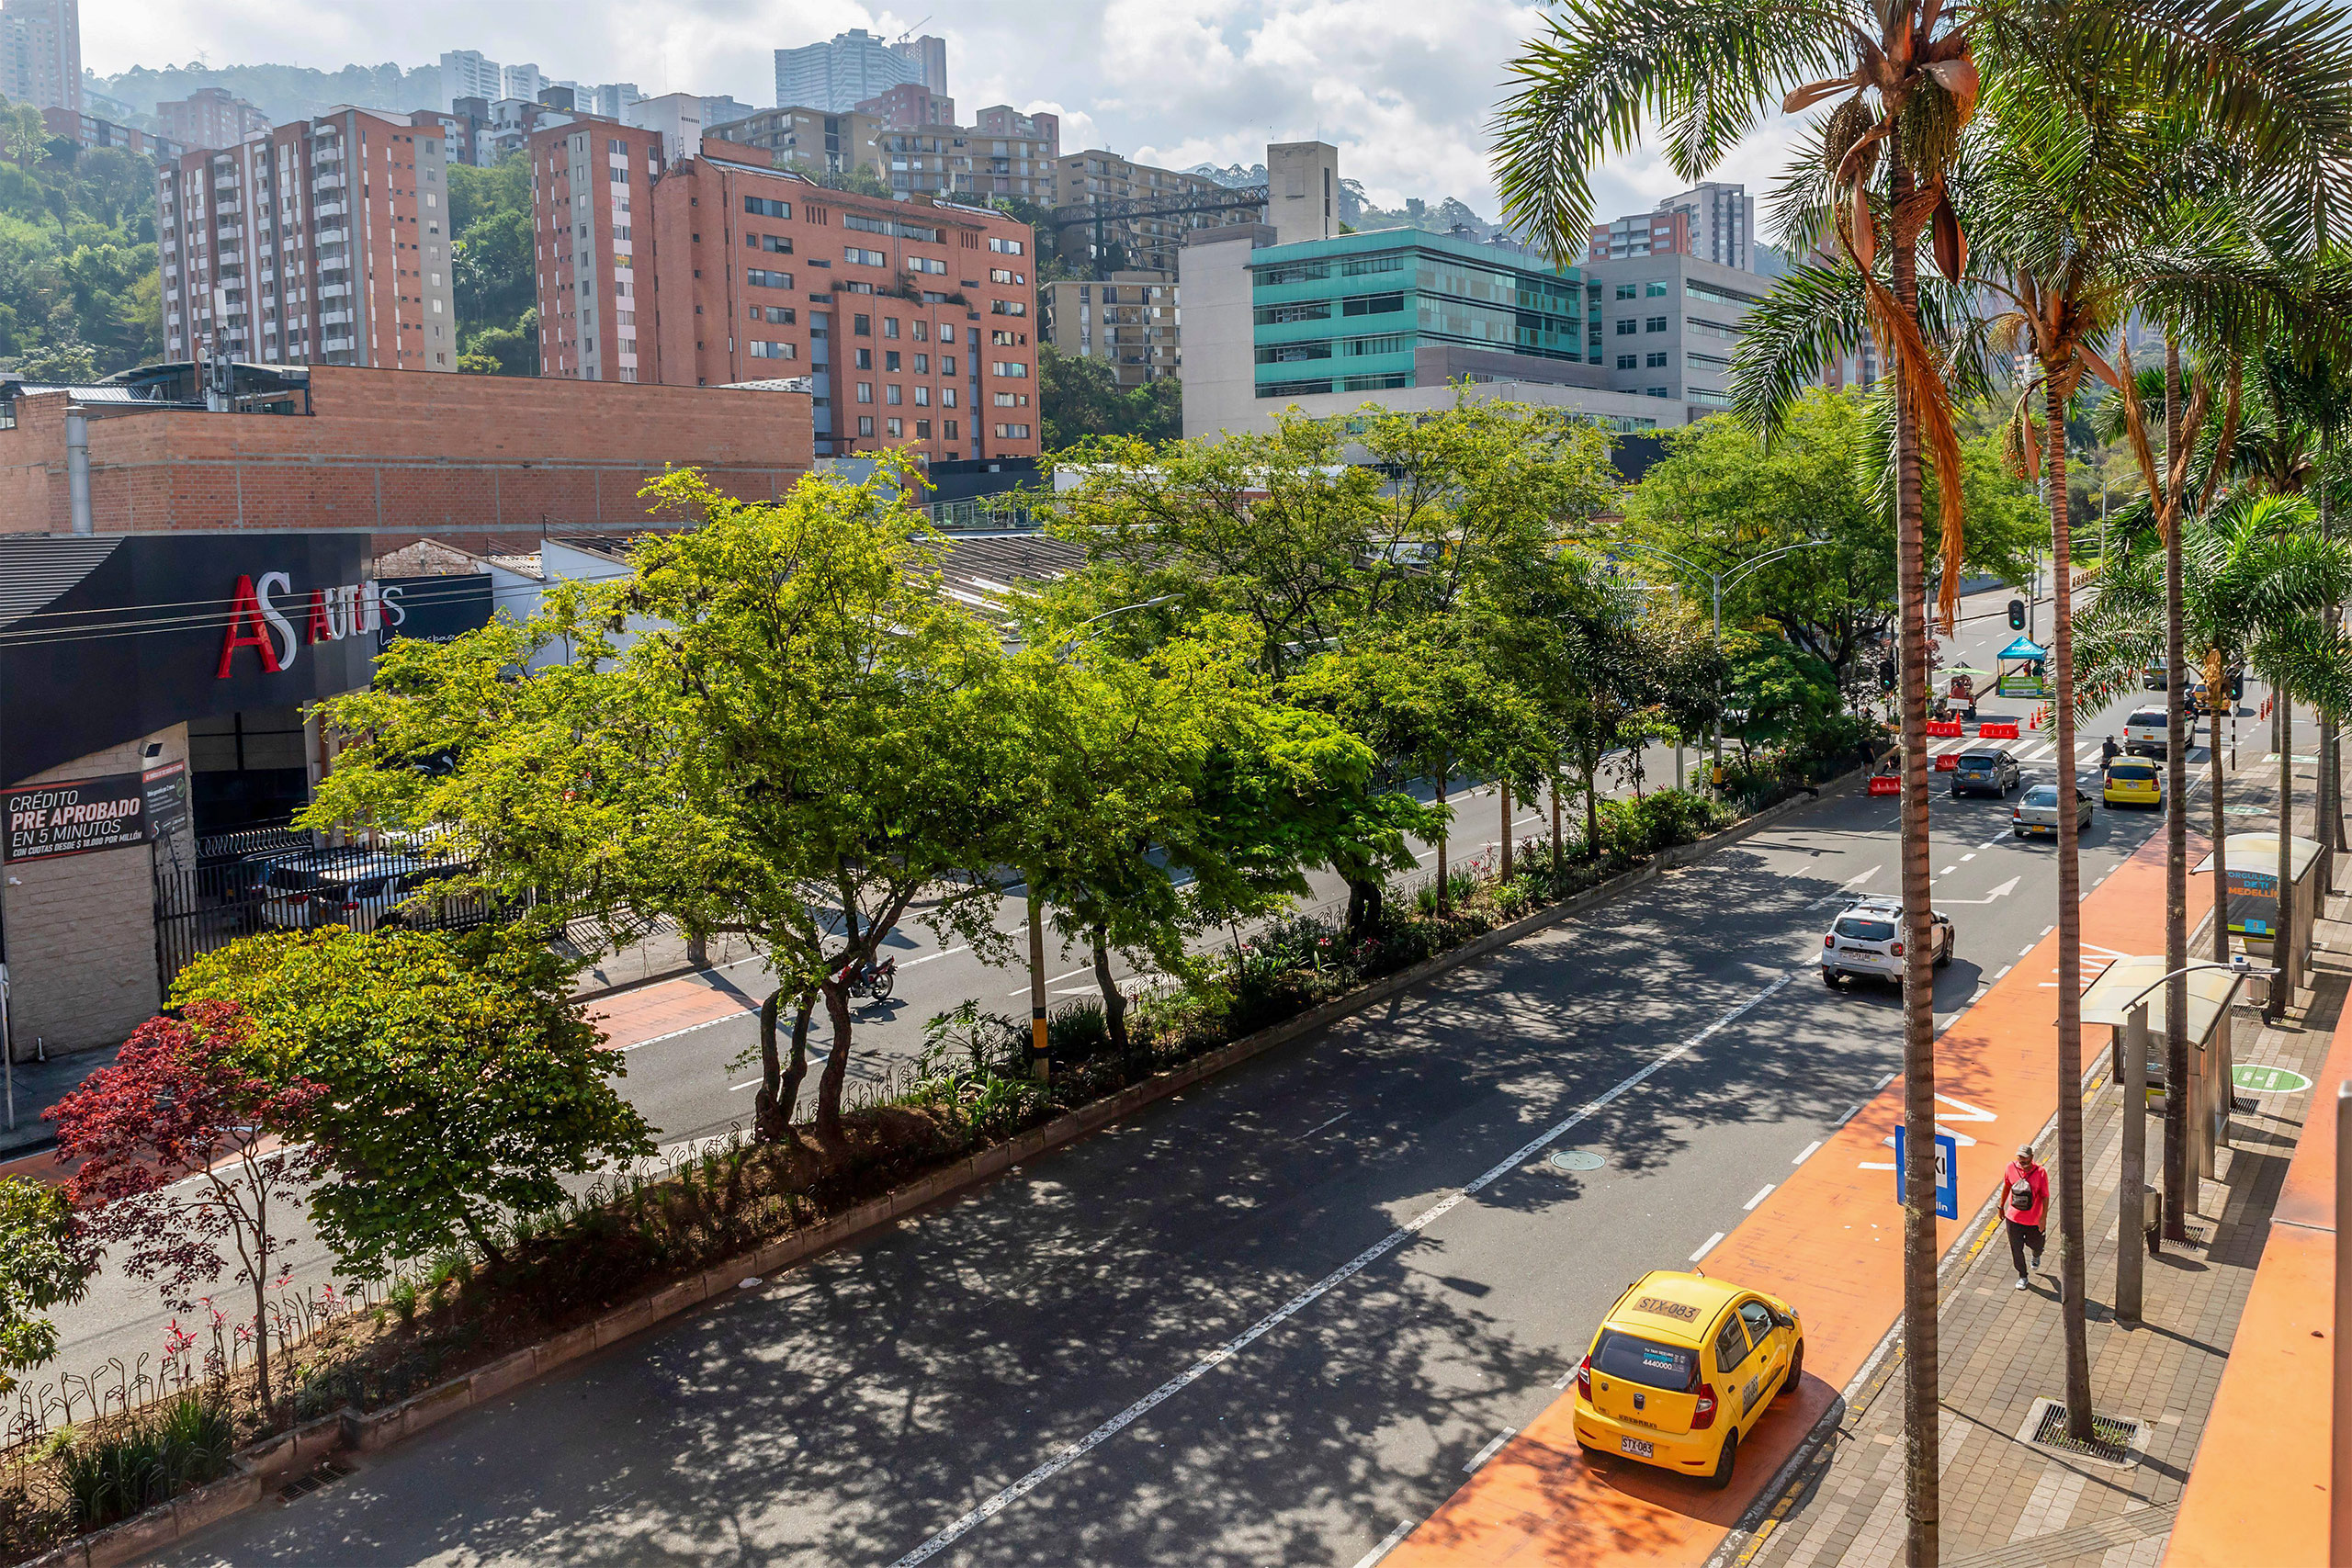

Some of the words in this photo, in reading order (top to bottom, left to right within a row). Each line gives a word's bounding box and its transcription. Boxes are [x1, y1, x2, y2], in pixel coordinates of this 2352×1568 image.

[217, 571, 297, 679] AS
[9, 790, 79, 812] CRÉDITO
[11, 809, 48, 831] PRE
[50, 797, 141, 827] APROBADO
[12, 830, 35, 847] EN
[39, 829, 49, 843] 5
[53, 818, 122, 841] MINUTOS
[13, 848, 28, 857] CON
[28, 844, 53, 855] CUOTAS
[54, 840, 76, 852] DESDE
[76, 840, 82, 849] $
[83, 837, 104, 847] 18.000
[104, 835, 119, 845] POR
[119, 830, 142, 842] MILLÓN
[2260, 881, 2269, 889] TI
[1639, 1298, 1697, 1319] STX-083
[1643, 1359, 1673, 1371] 4440000
[1623, 1438, 1652, 1454] STX-083
